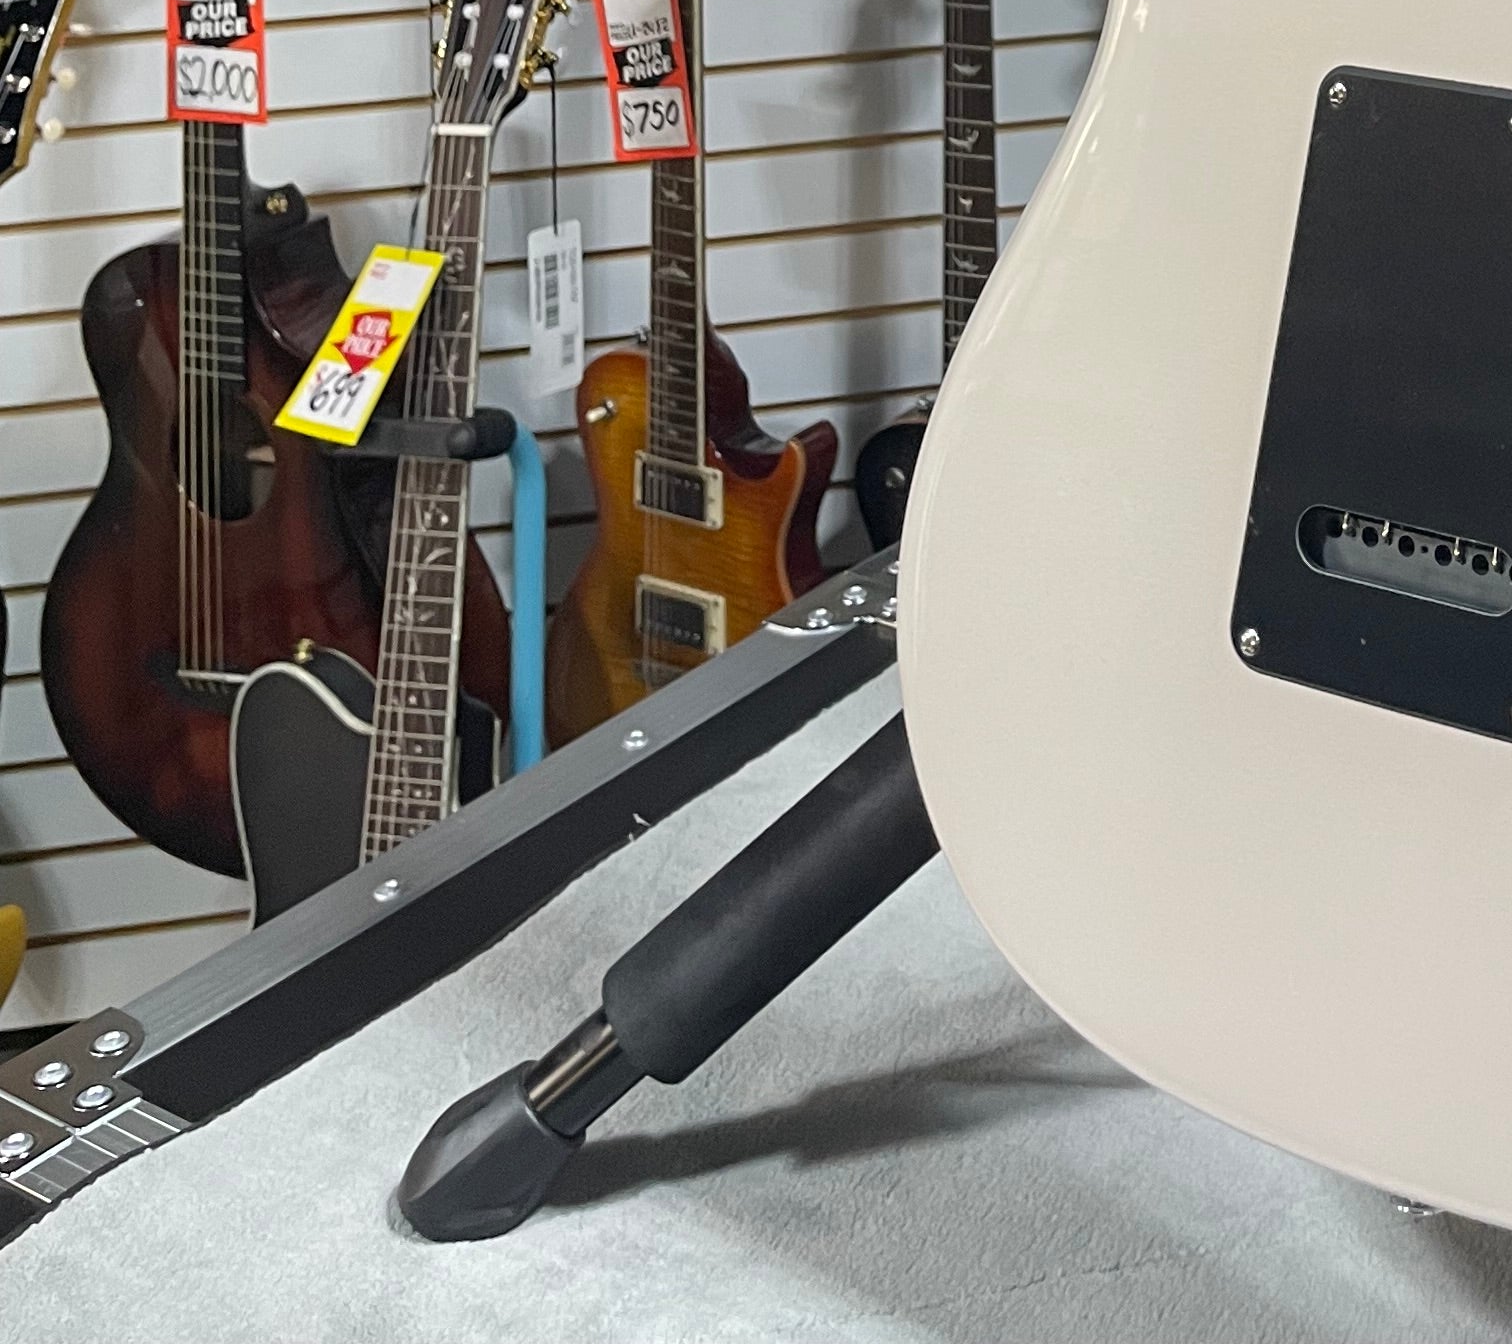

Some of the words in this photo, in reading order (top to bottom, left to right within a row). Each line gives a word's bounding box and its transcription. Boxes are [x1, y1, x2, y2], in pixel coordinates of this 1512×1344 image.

[190, 2, 237, 22] OUR
[185, 15, 248, 41] PRICE
[625, 41, 663, 65] OUR
[622, 54, 673, 85] PRICE
[622, 99, 681, 139] $750
